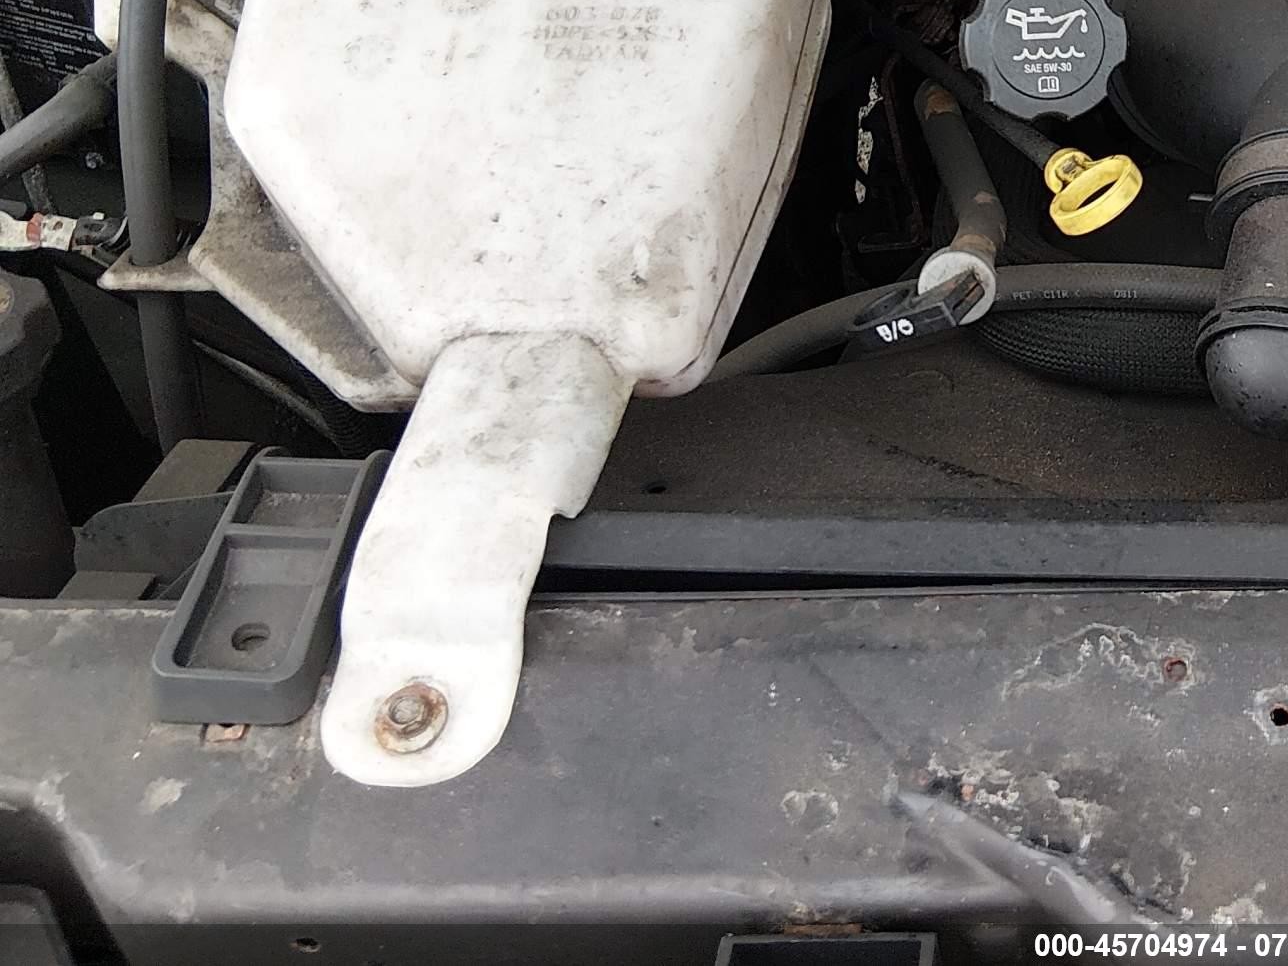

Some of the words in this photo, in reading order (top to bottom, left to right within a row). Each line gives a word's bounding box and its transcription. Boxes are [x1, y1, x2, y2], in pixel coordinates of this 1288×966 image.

[1024, 64, 1042, 73] SAE
[1043, 62, 1072, 72] 5W-30
[1012, 290, 1032, 300] PET
